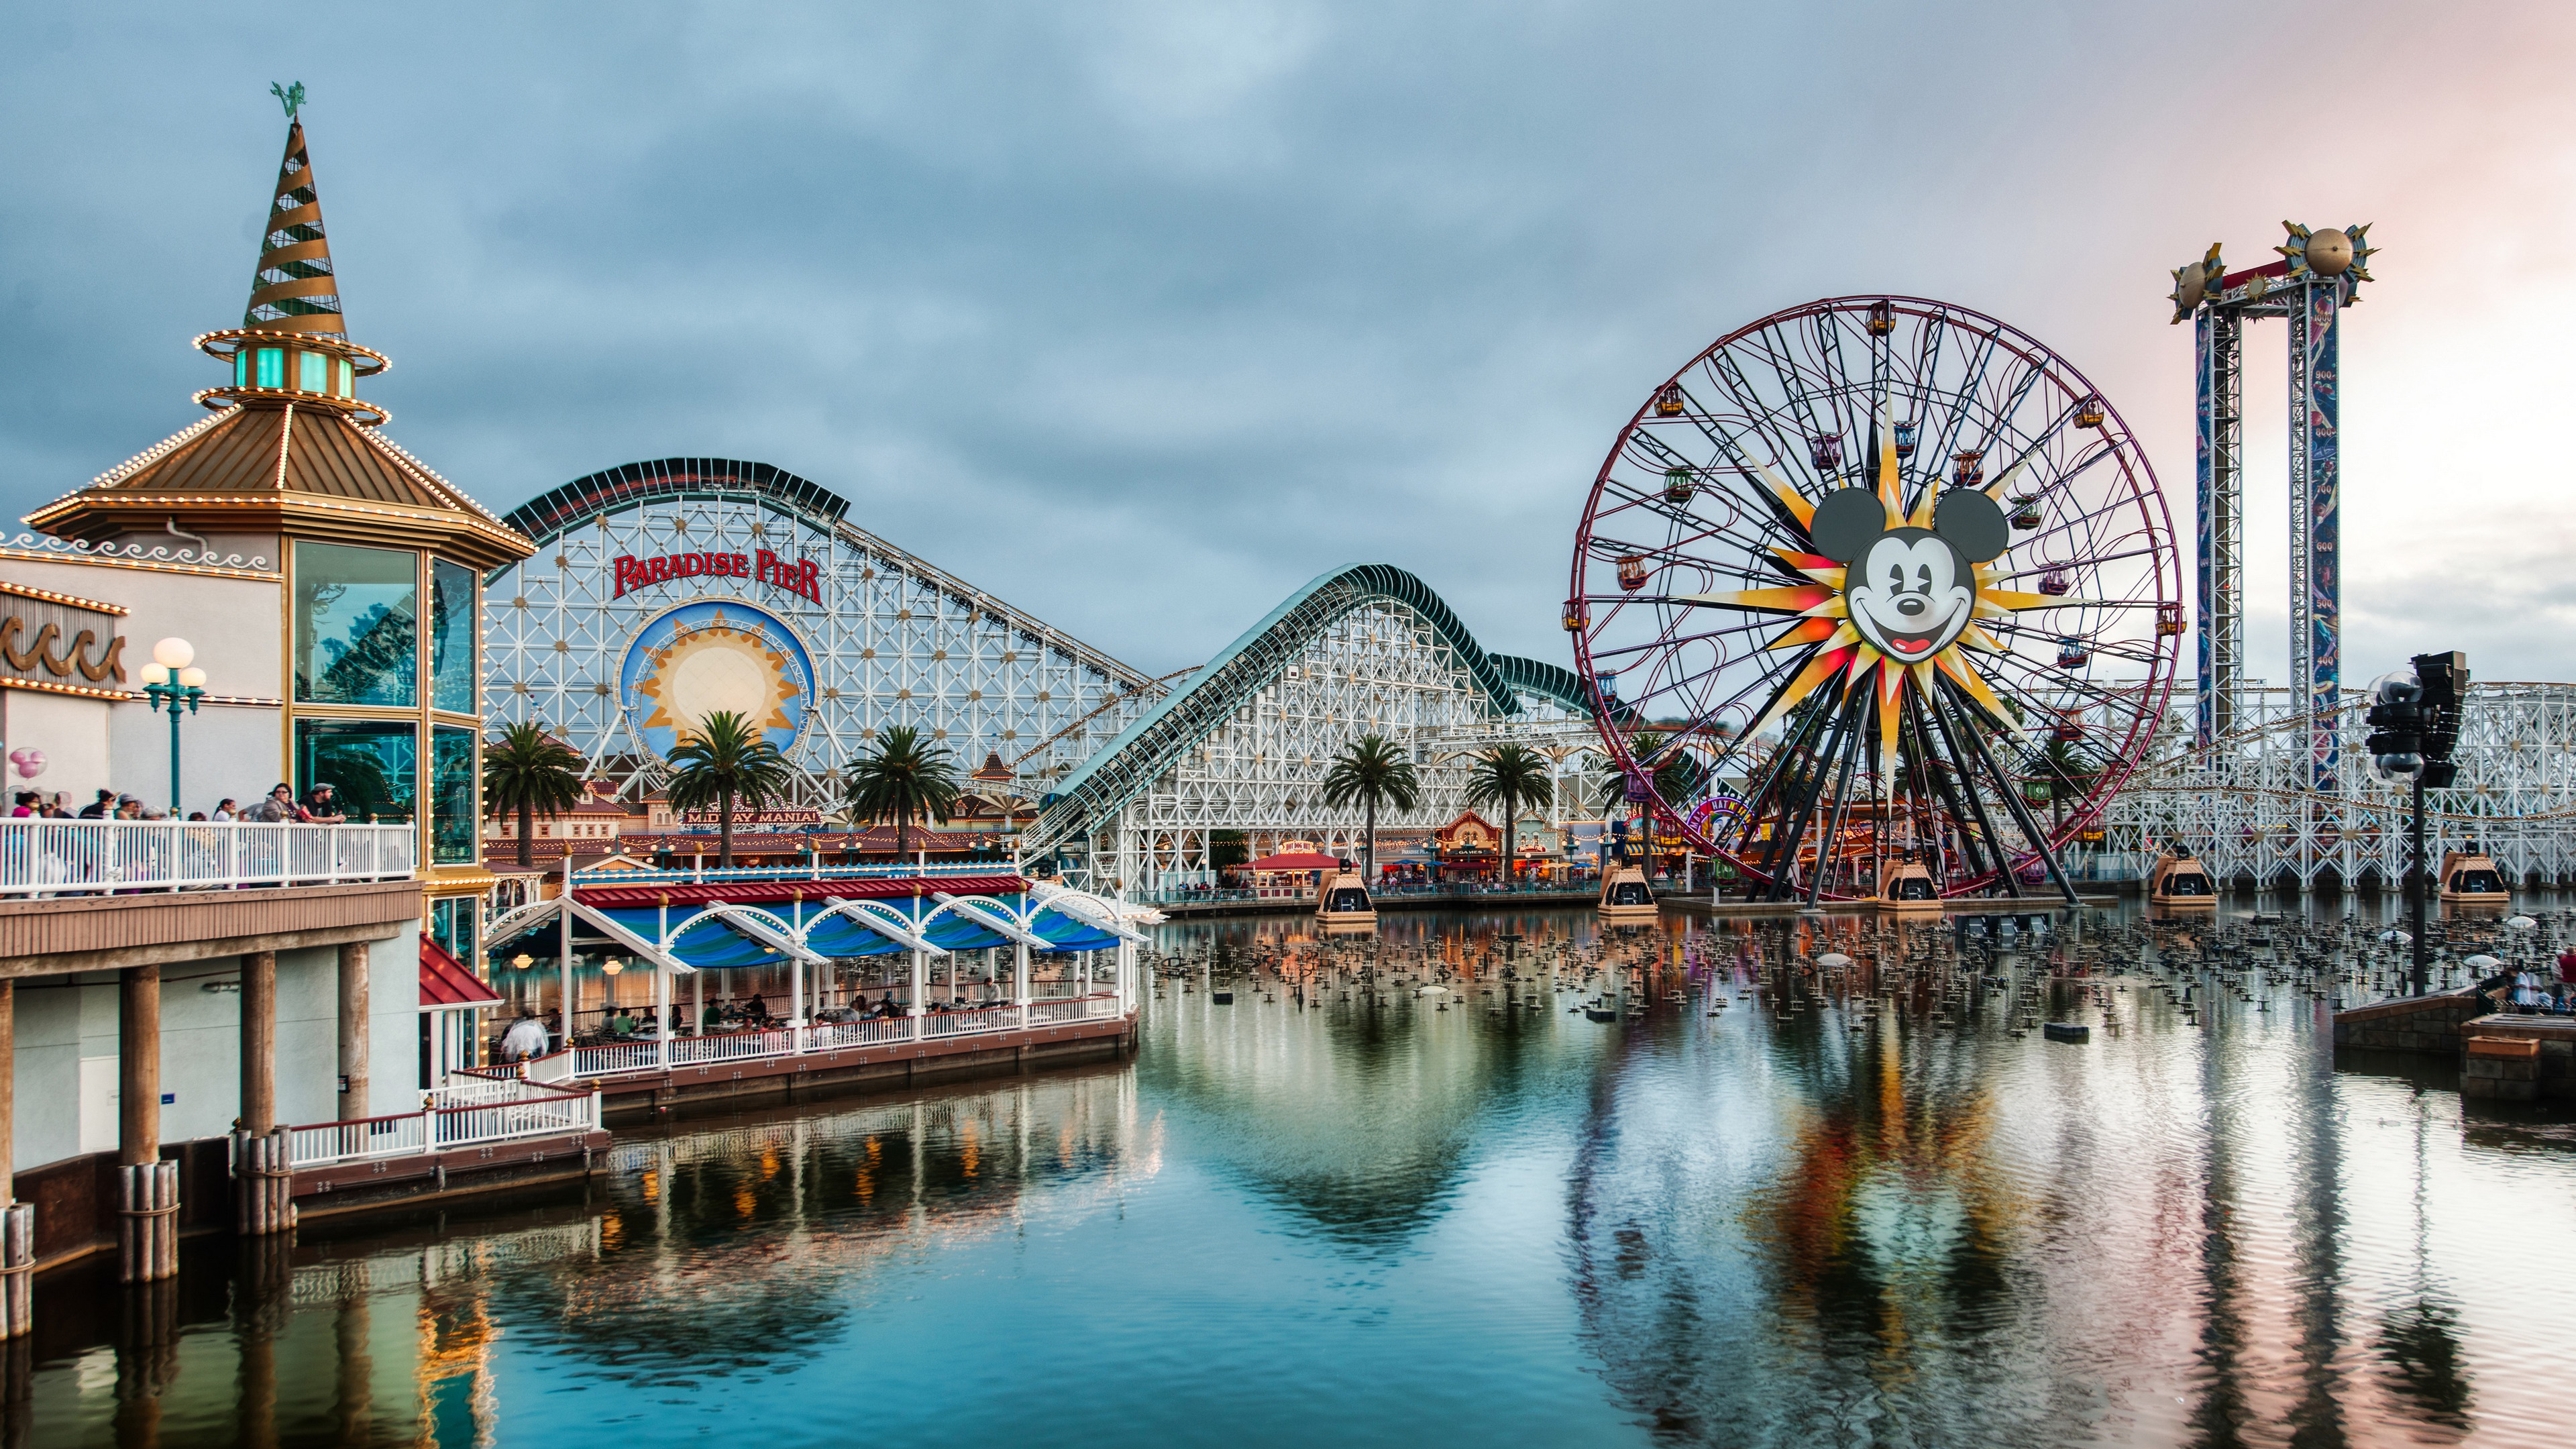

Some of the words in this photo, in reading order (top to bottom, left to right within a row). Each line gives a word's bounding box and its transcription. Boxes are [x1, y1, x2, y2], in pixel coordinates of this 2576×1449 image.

[2314, 313, 2332, 323] 1000
[2315, 370, 2332, 380] 900
[2316, 427, 2332, 437] 800
[2316, 485, 2332, 494] 700
[2316, 542, 2332, 551] 600
[613, 552, 749, 600] PARADISE
[755, 549, 822, 606] PIER
[2316, 600, 2332, 608] 500
[2317, 656, 2333, 665] 400
[1711, 800, 1728, 810] HAT
[688, 813, 752, 823] MIDAY
[758, 812, 816, 822] MANIA!
